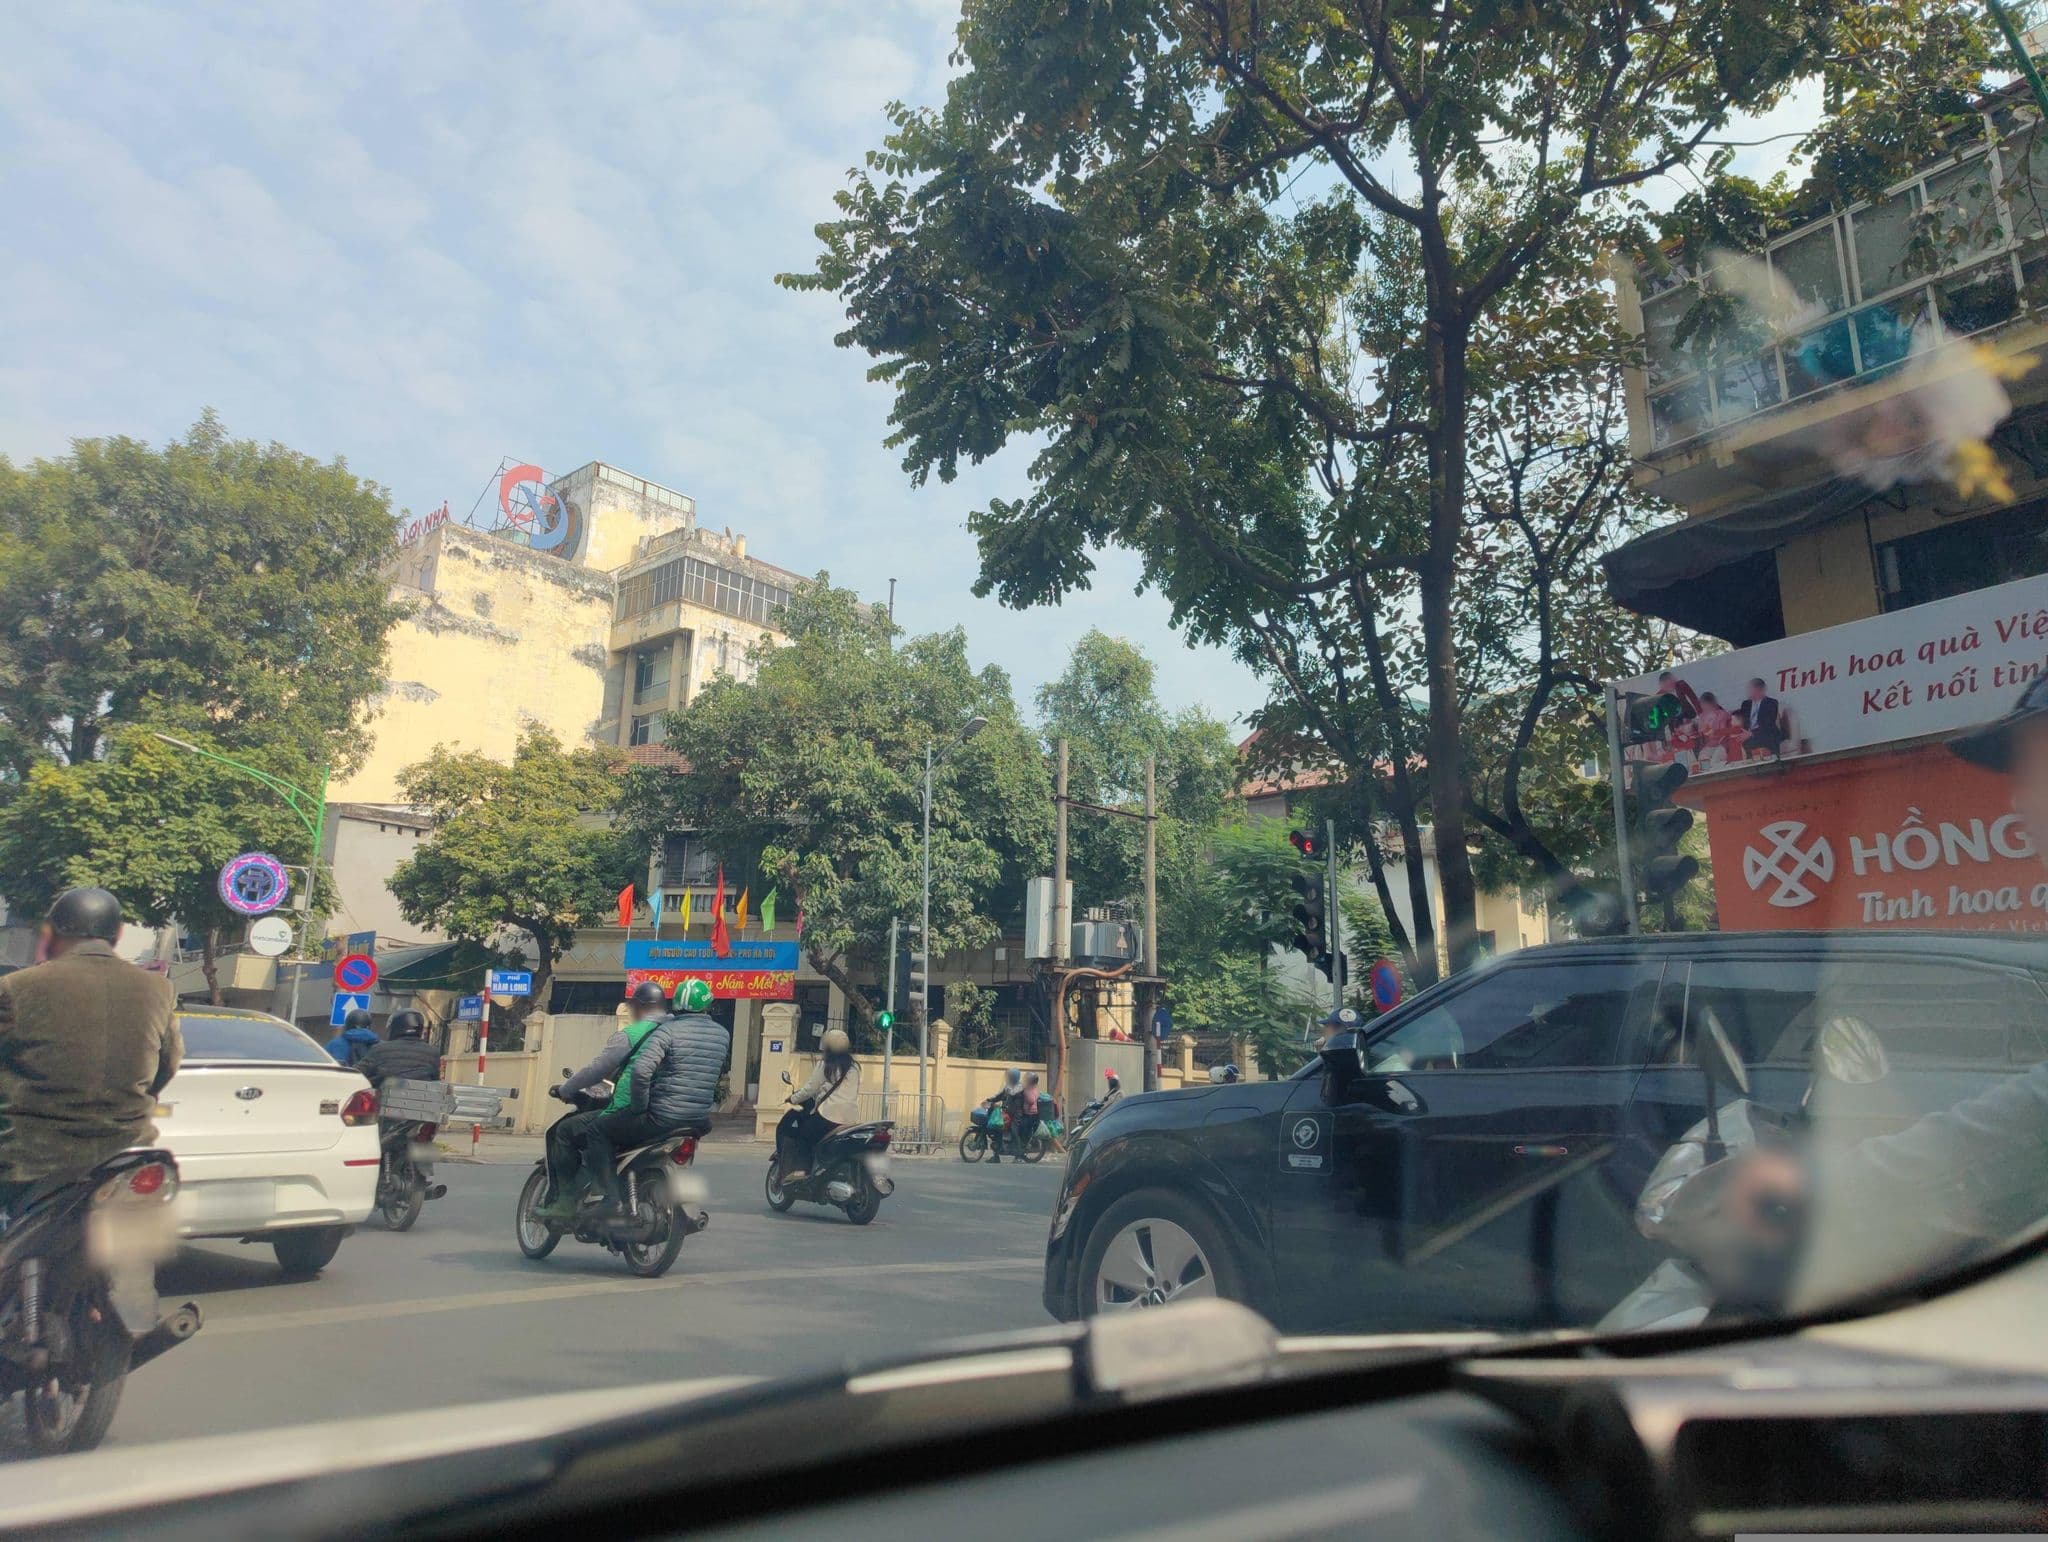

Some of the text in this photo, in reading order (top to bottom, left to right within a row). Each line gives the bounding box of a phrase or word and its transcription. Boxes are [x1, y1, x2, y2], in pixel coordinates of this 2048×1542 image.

[1776, 661, 1837, 692] Tinh
[1848, 648, 1906, 677] hoa
[1918, 626, 1982, 665] quà
[1862, 680, 1913, 715] Kết
[1926, 666, 1979, 702] nối
[1849, 806, 2036, 876] HỒNG
[1857, 888, 1936, 923] Tinh
[1947, 884, 2023, 916] hoa
[510, 983, 528, 992] LONG
[716, 975, 745, 990] Năm
[747, 975, 774, 990] Mới
[239, 1089, 261, 1099] KIA
